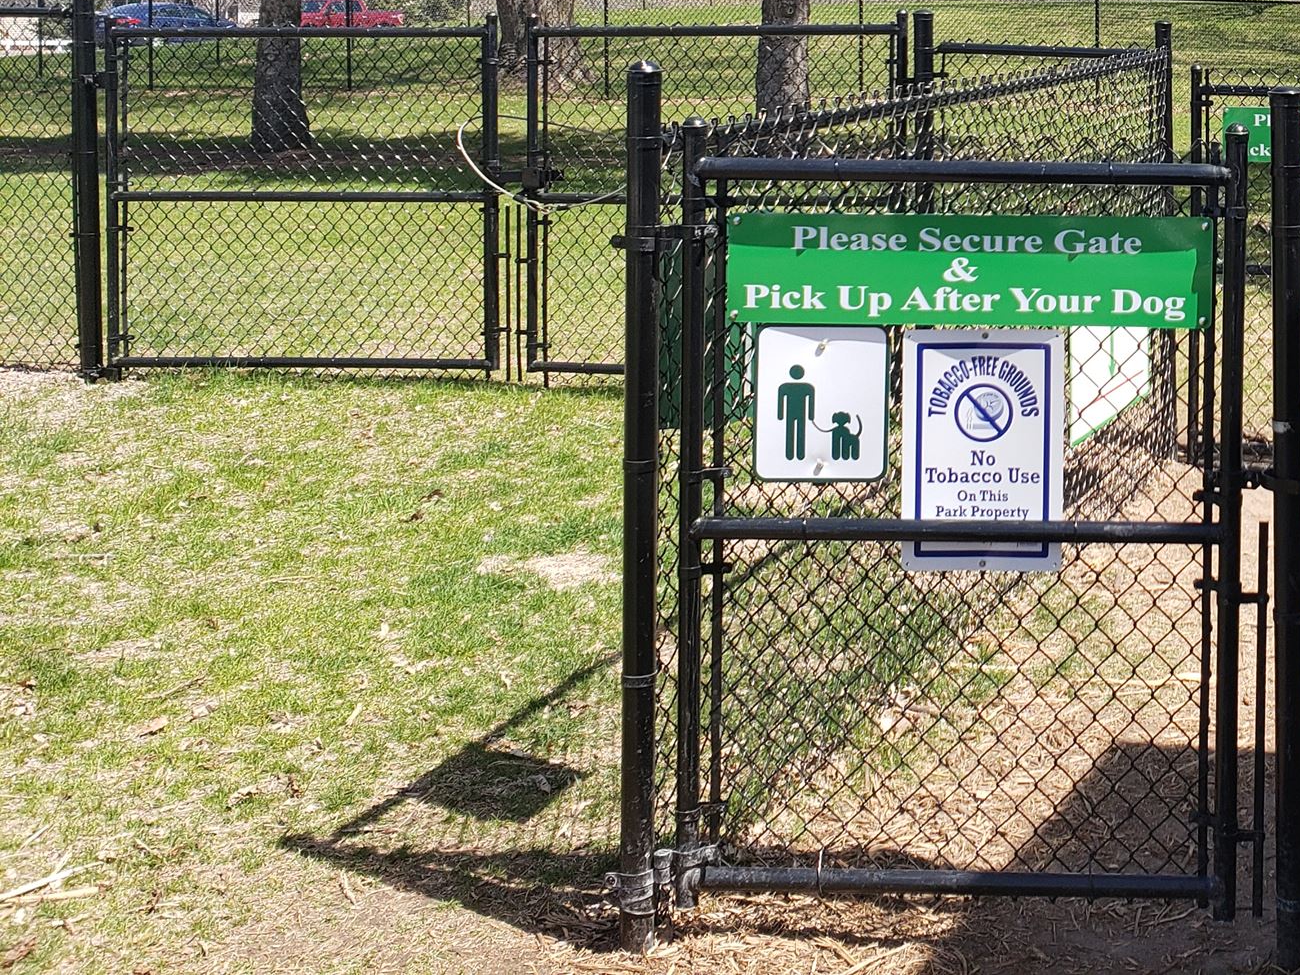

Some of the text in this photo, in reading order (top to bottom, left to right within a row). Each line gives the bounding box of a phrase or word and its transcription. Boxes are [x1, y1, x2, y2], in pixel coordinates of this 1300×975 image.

[791, 226, 1142, 255] Please Secure Gate
[943, 258, 978, 283] &
[743, 284, 1186, 320] Pick Up After Your Dog
[928, 356, 1040, 417] TOBACCO-FREE GROUNDS
[970, 450, 996, 466] No
[925, 467, 1040, 484] Tobacco Use
[957, 490, 1009, 502] On This
[936, 506, 1029, 521] Park Property
